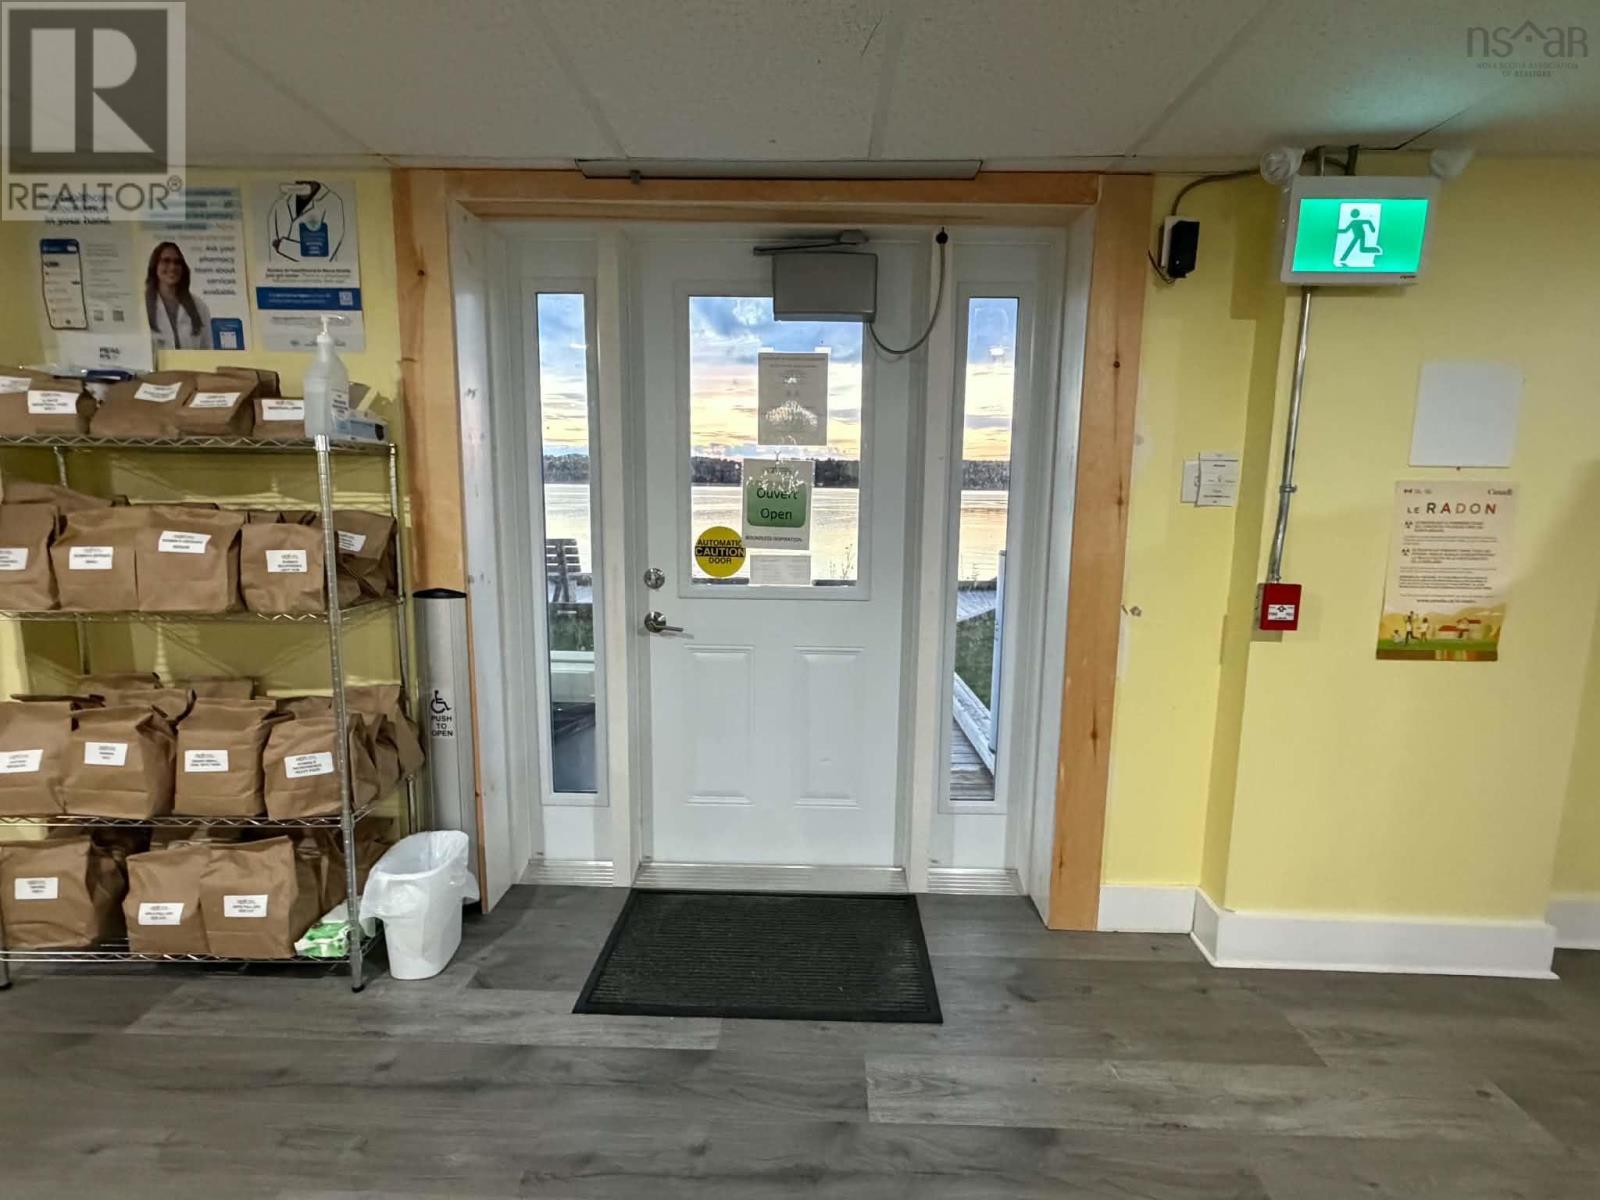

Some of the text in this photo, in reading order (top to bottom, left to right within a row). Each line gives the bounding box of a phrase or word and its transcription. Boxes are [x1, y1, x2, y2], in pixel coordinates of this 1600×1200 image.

[756, 487, 798, 500] Ouvert
[760, 507, 793, 521] Open
[1406, 502, 1497, 515] LE RADON
[695, 547, 745, 556] CAUTION
